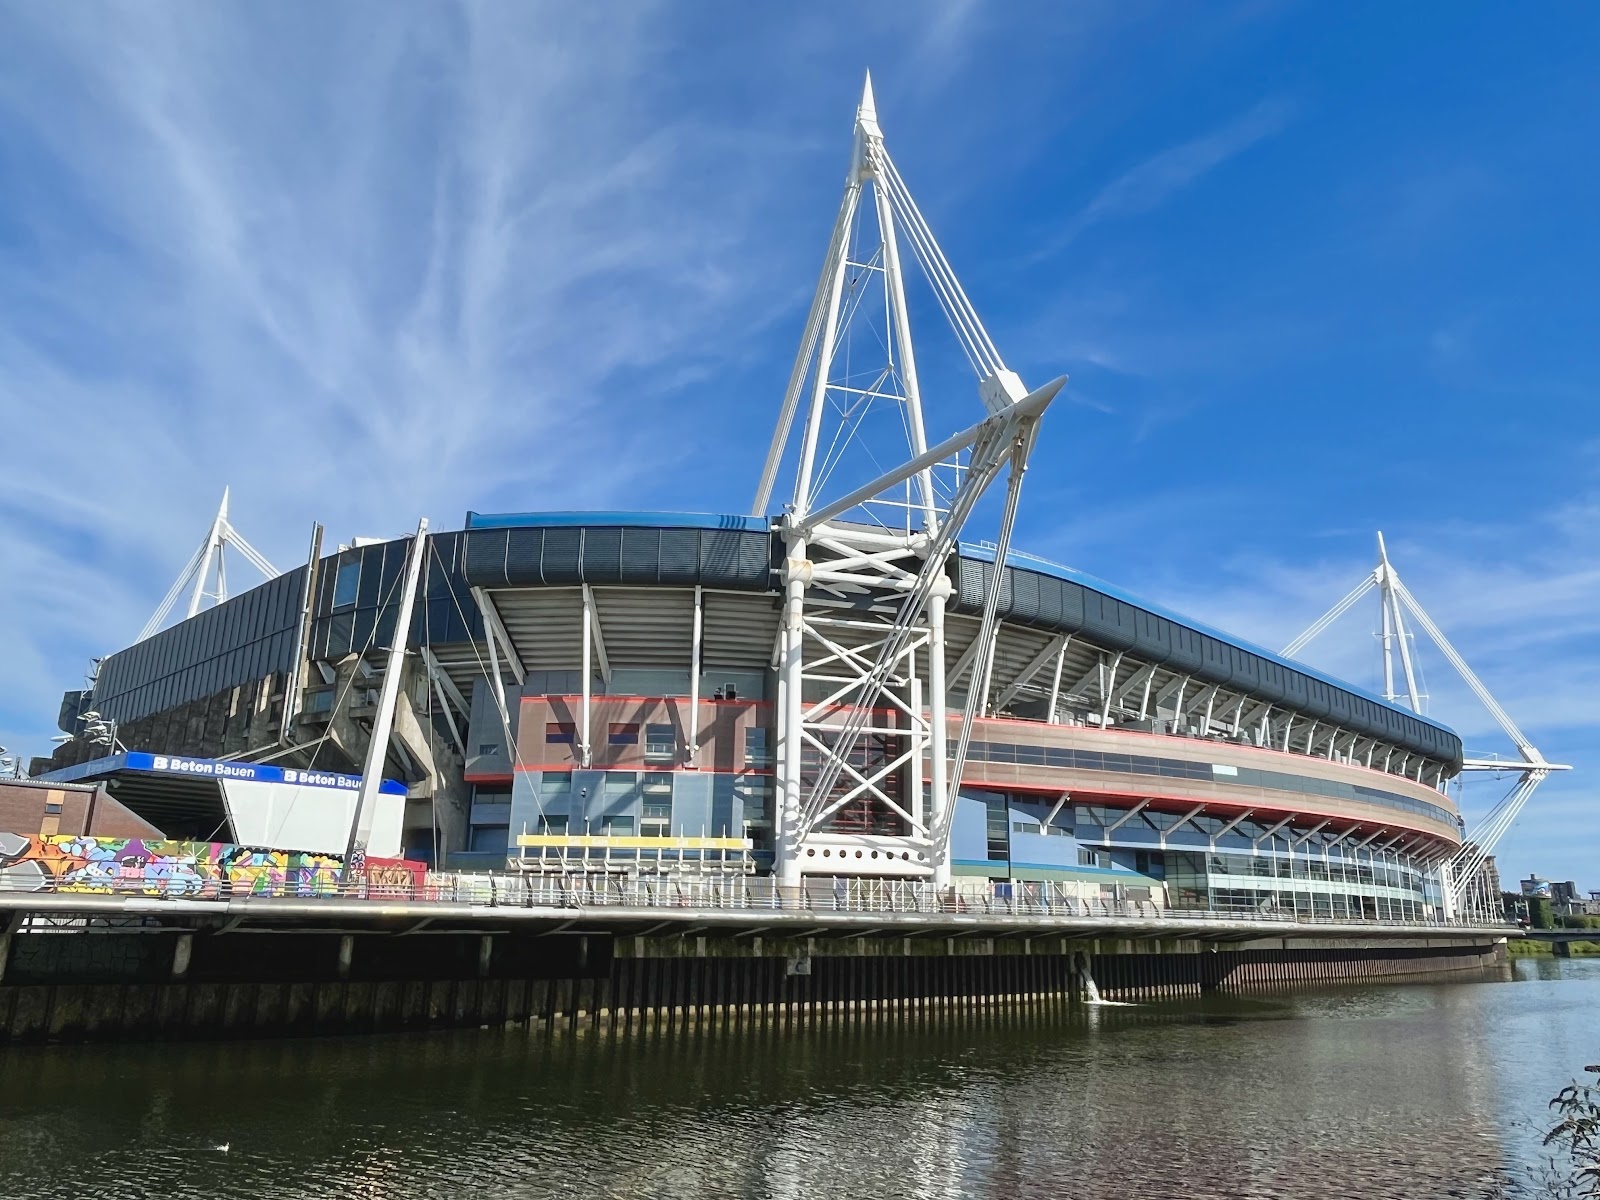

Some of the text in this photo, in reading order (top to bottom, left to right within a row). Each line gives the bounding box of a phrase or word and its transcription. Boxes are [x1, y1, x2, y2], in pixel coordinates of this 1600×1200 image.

[170, 759, 212, 774] Beton
[214, 763, 255, 778] Bauen
[299, 772, 335, 786] Beton
